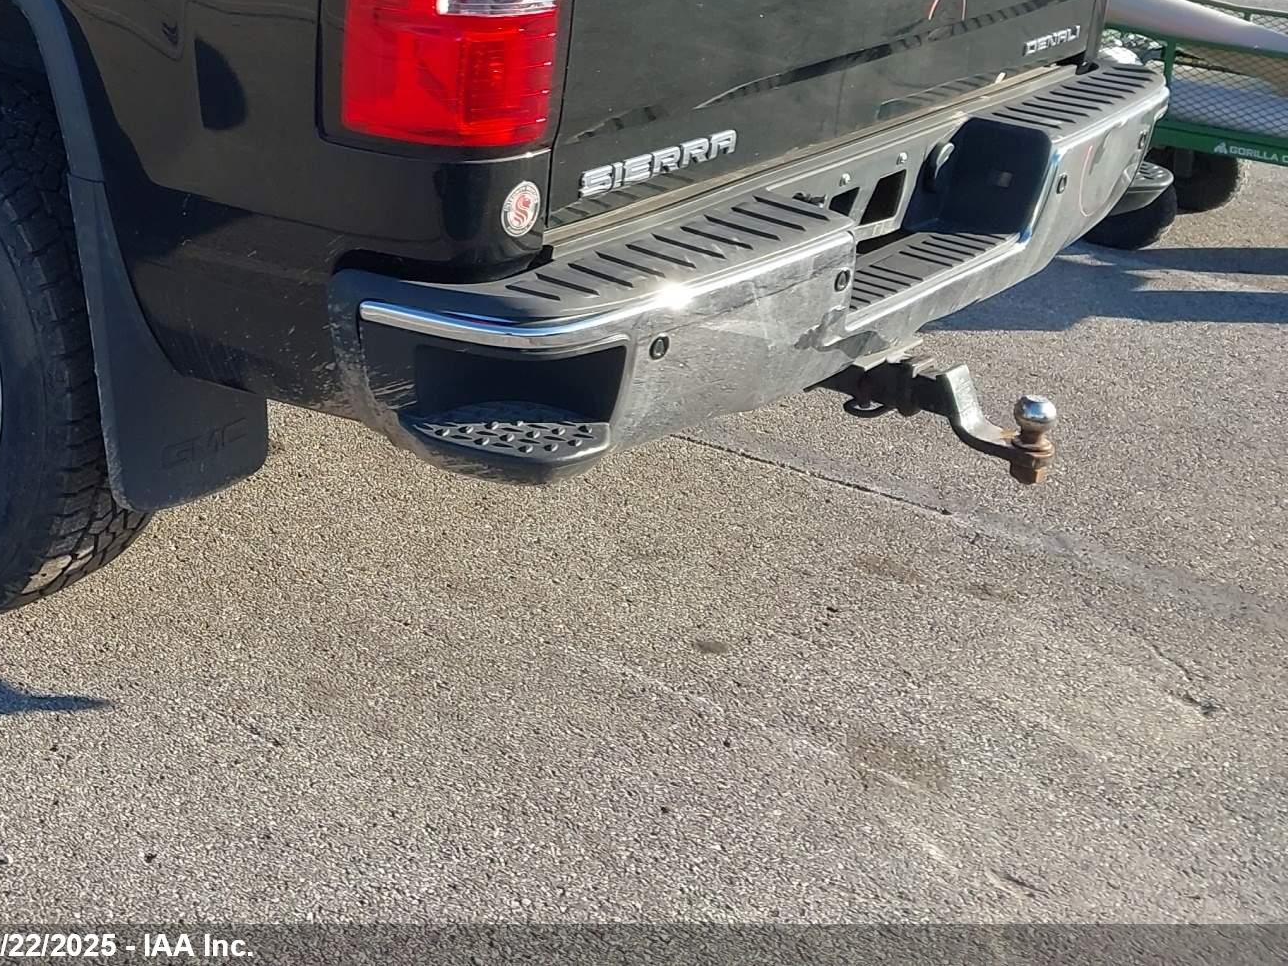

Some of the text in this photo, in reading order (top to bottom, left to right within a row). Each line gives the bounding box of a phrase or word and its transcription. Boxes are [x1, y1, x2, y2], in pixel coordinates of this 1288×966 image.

[1023, 25, 1081, 55] DENALI
[579, 129, 737, 197] SIERRA
[1229, 145, 1279, 162] GORILLA
[160, 417, 248, 469] GMC
